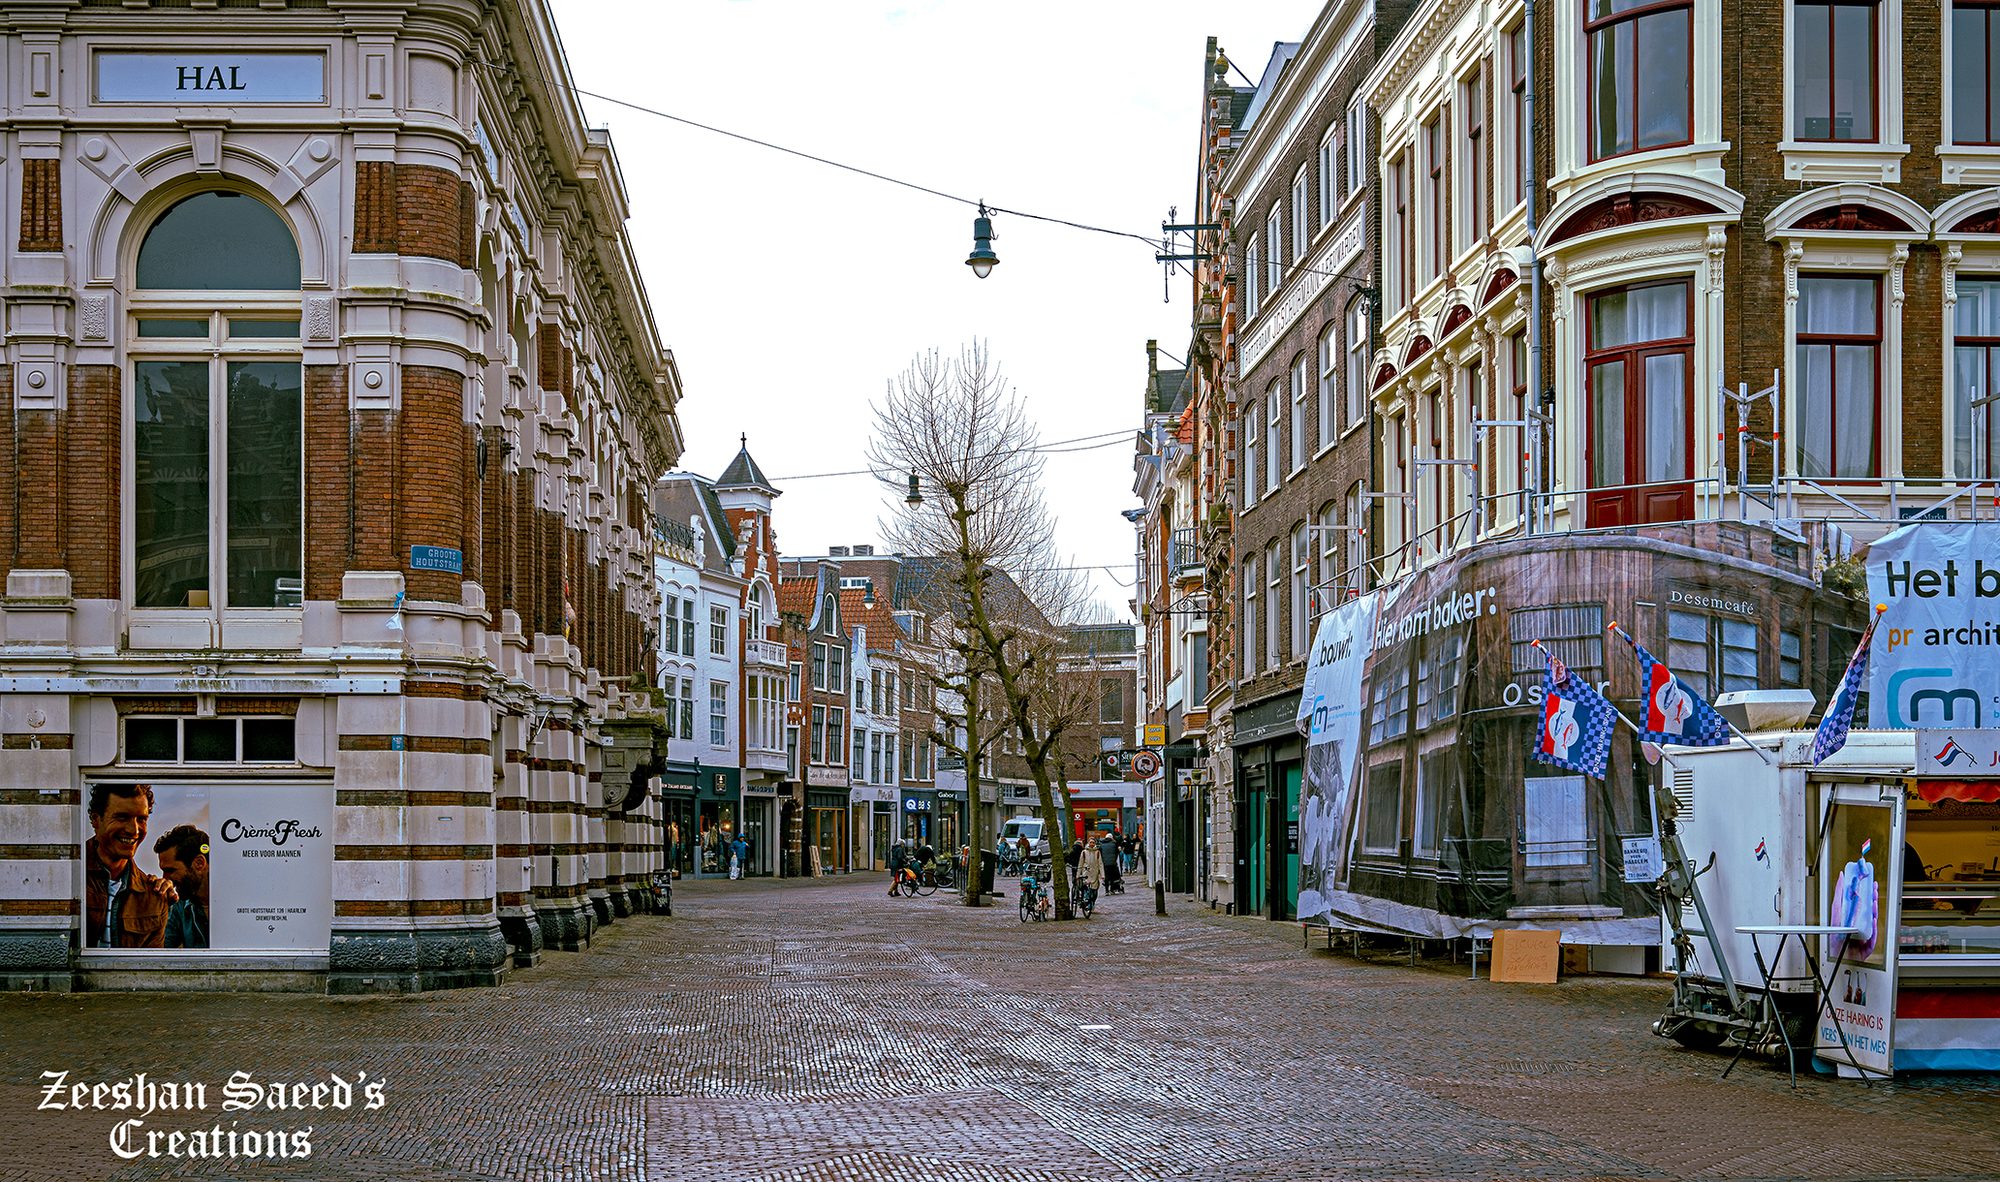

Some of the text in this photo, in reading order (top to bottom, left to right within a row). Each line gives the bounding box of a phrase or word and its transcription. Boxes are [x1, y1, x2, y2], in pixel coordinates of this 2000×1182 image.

[175, 66, 247, 90] HAL
[428, 549, 456, 560] GROOTE
[1886, 559, 1959, 598] Het
[1671, 590, 1754, 615] Desemcafé
[1374, 617, 1398, 651] Hier
[1887, 626, 1914, 653] pr
[1597, 726, 1608, 753] HARING
[937, 791, 955, 799] Gabor
[242, 849, 302, 858] MEER VOOR MANNEN
[1825, 1006, 1884, 1031] OZE HARING IS
[1821, 1026, 1837, 1043] VERS
[1854, 1034, 1869, 1050] HET
[1870, 1038, 1887, 1055] MES
